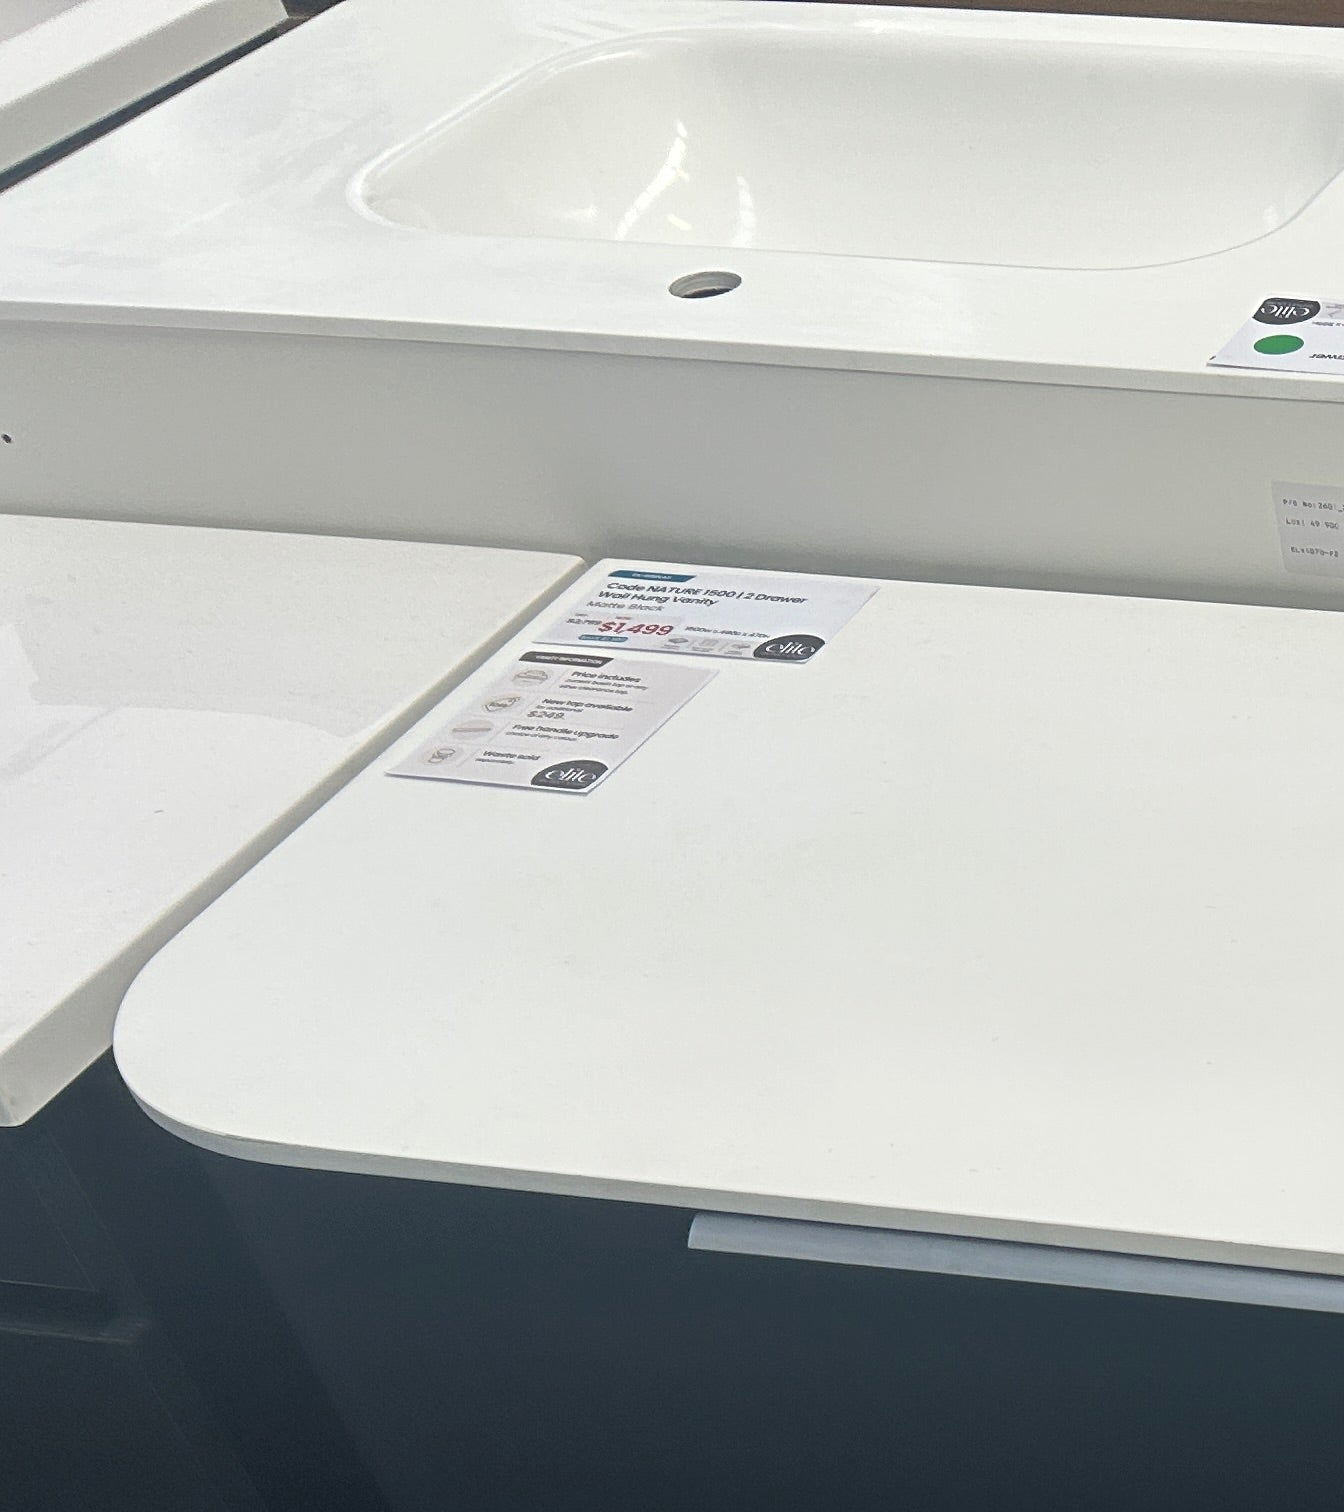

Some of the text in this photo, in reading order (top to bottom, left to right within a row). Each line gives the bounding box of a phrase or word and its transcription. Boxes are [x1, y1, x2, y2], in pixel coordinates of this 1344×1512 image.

[597, 590, 719, 606] Wall Hung Vanity
[606, 582, 646, 593] Code
[648, 585, 699, 596] NATURE
[703, 588, 737, 599] 1500
[755, 593, 808, 604] Drawer
[586, 600, 665, 612] Matte Black
[598, 620, 675, 636] $1,499
